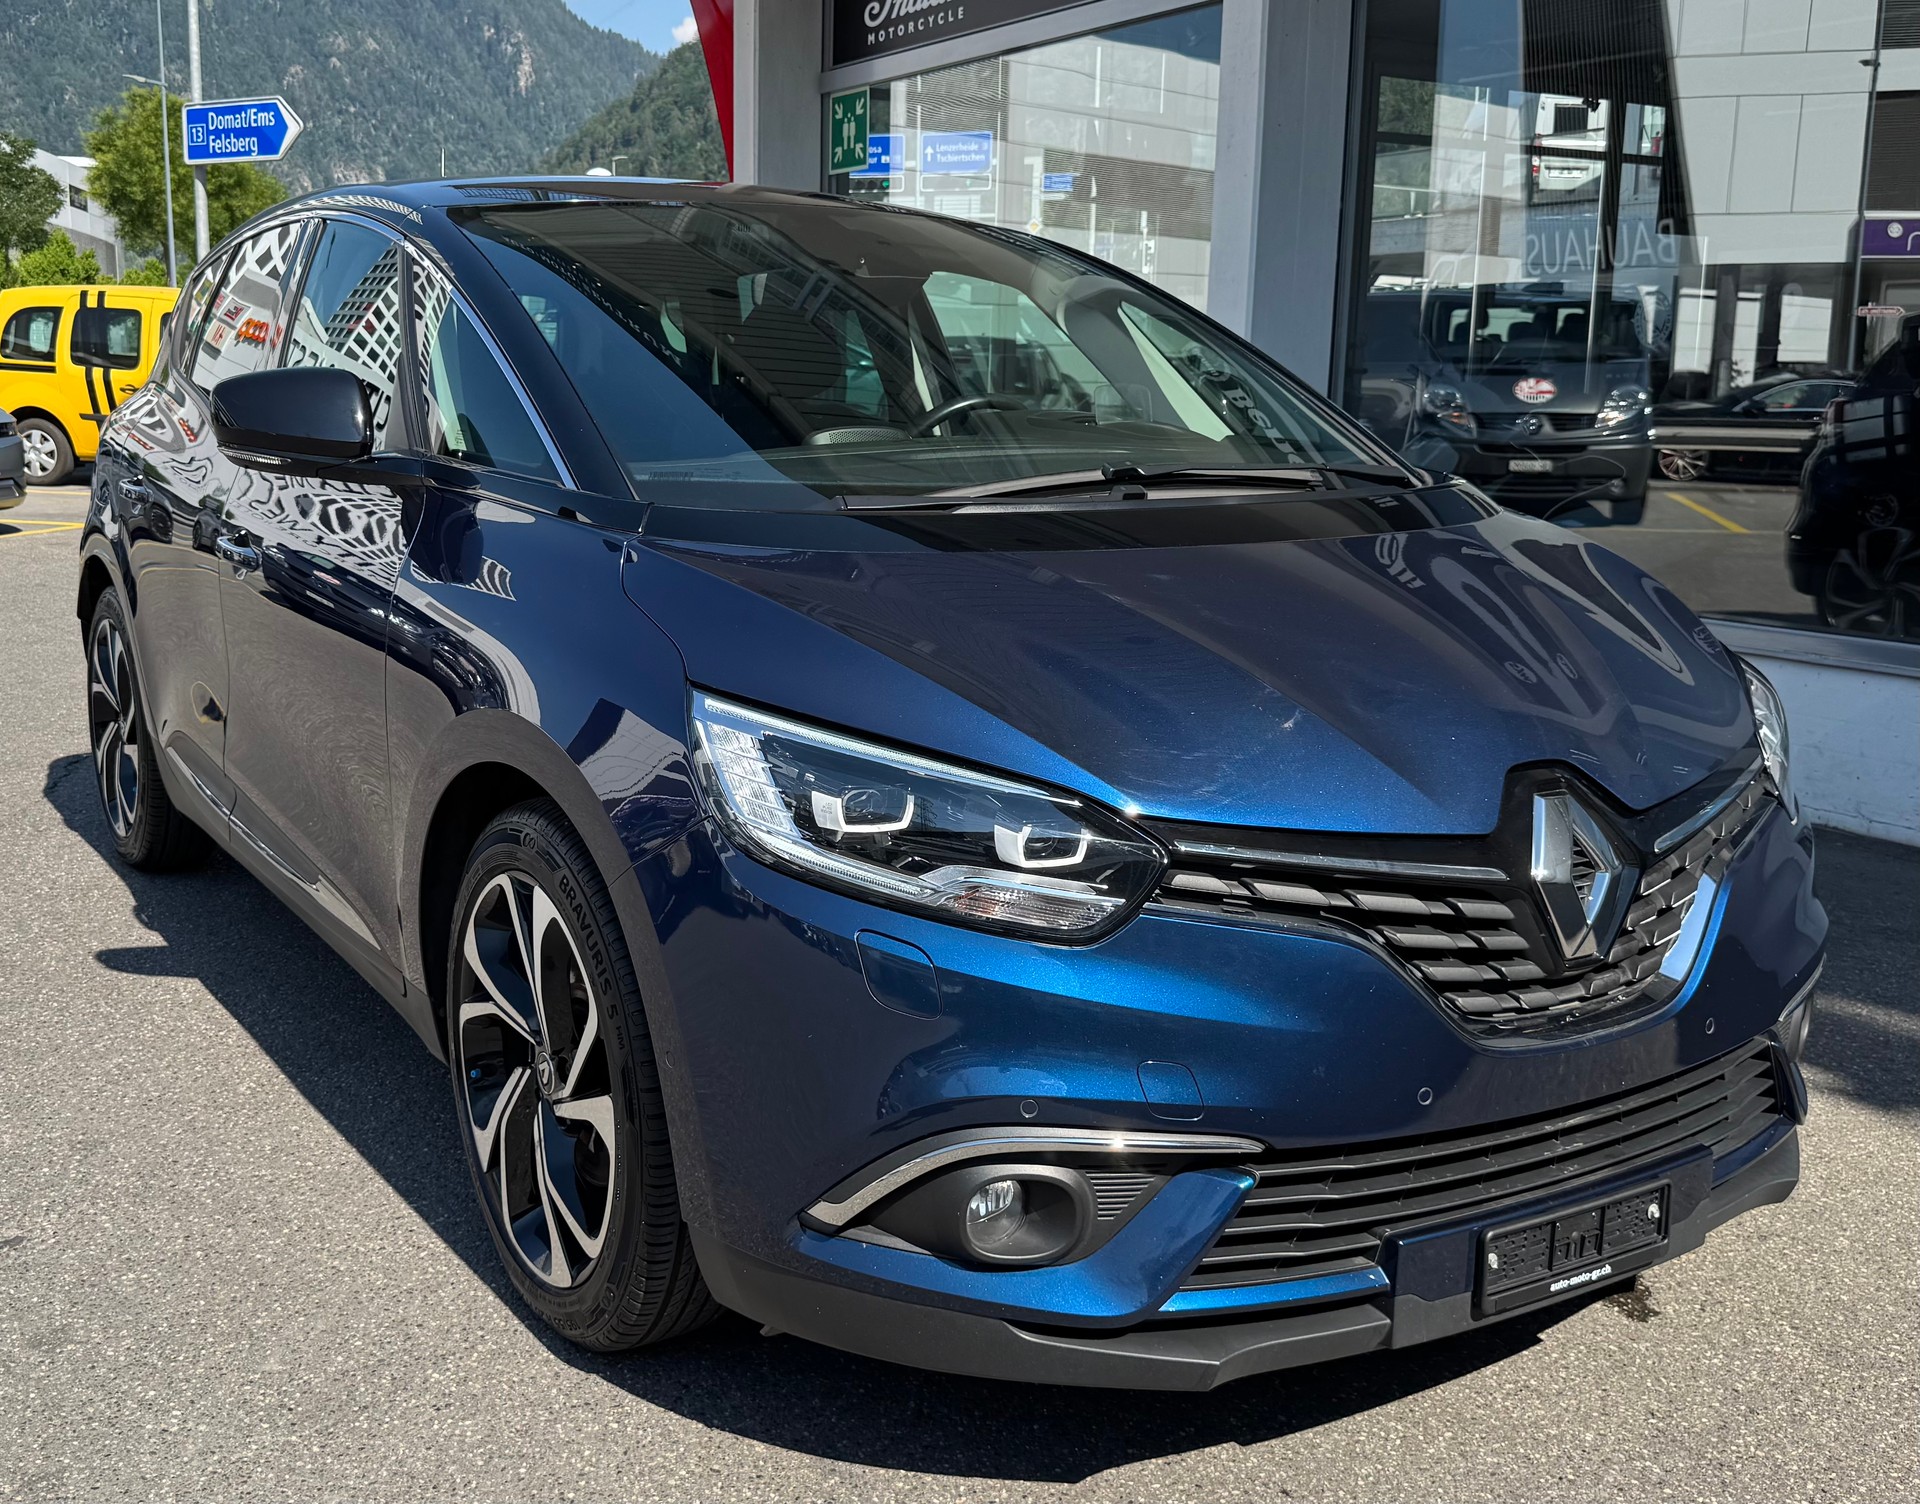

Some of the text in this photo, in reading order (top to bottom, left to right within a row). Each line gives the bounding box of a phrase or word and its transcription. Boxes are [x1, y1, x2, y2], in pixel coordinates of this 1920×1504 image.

[867, 6, 965, 45] MOTORCYCLE
[208, 108, 275, 130] Domat/Ems
[191, 126, 203, 142] 13
[209, 133, 258, 156] Felsberg
[558, 874, 612, 996] BRAVURIS
[606, 1004, 619, 1020] 5
[1550, 1263, 1612, 1292] auto-moto-gr.ch
